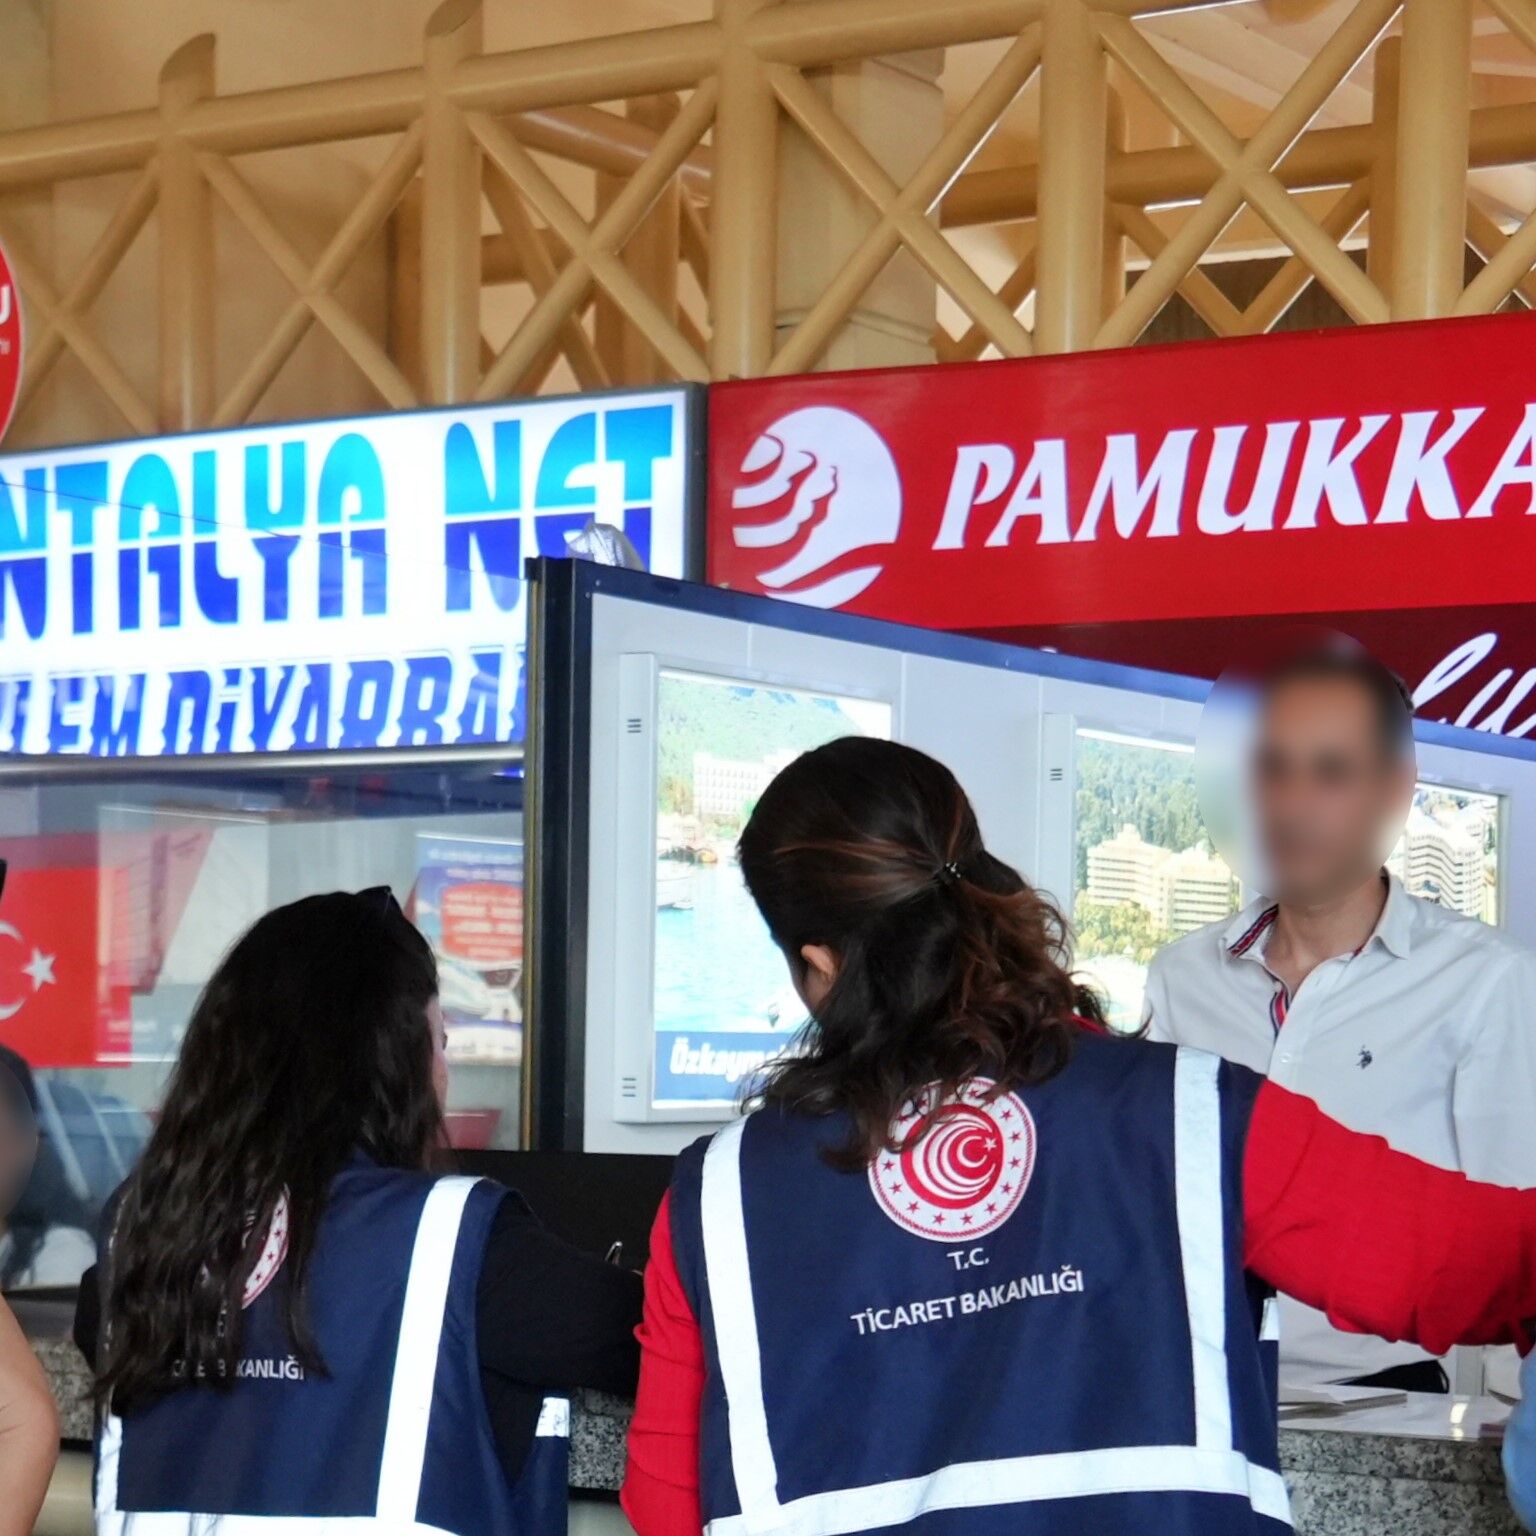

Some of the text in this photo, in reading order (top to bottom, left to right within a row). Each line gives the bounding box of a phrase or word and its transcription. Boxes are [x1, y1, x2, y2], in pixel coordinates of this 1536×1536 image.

[444, 404, 674, 614] NET
[947, 1247, 990, 1272] T.C.
[850, 1264, 1084, 1335] TİCARET BAKANLIĞI
